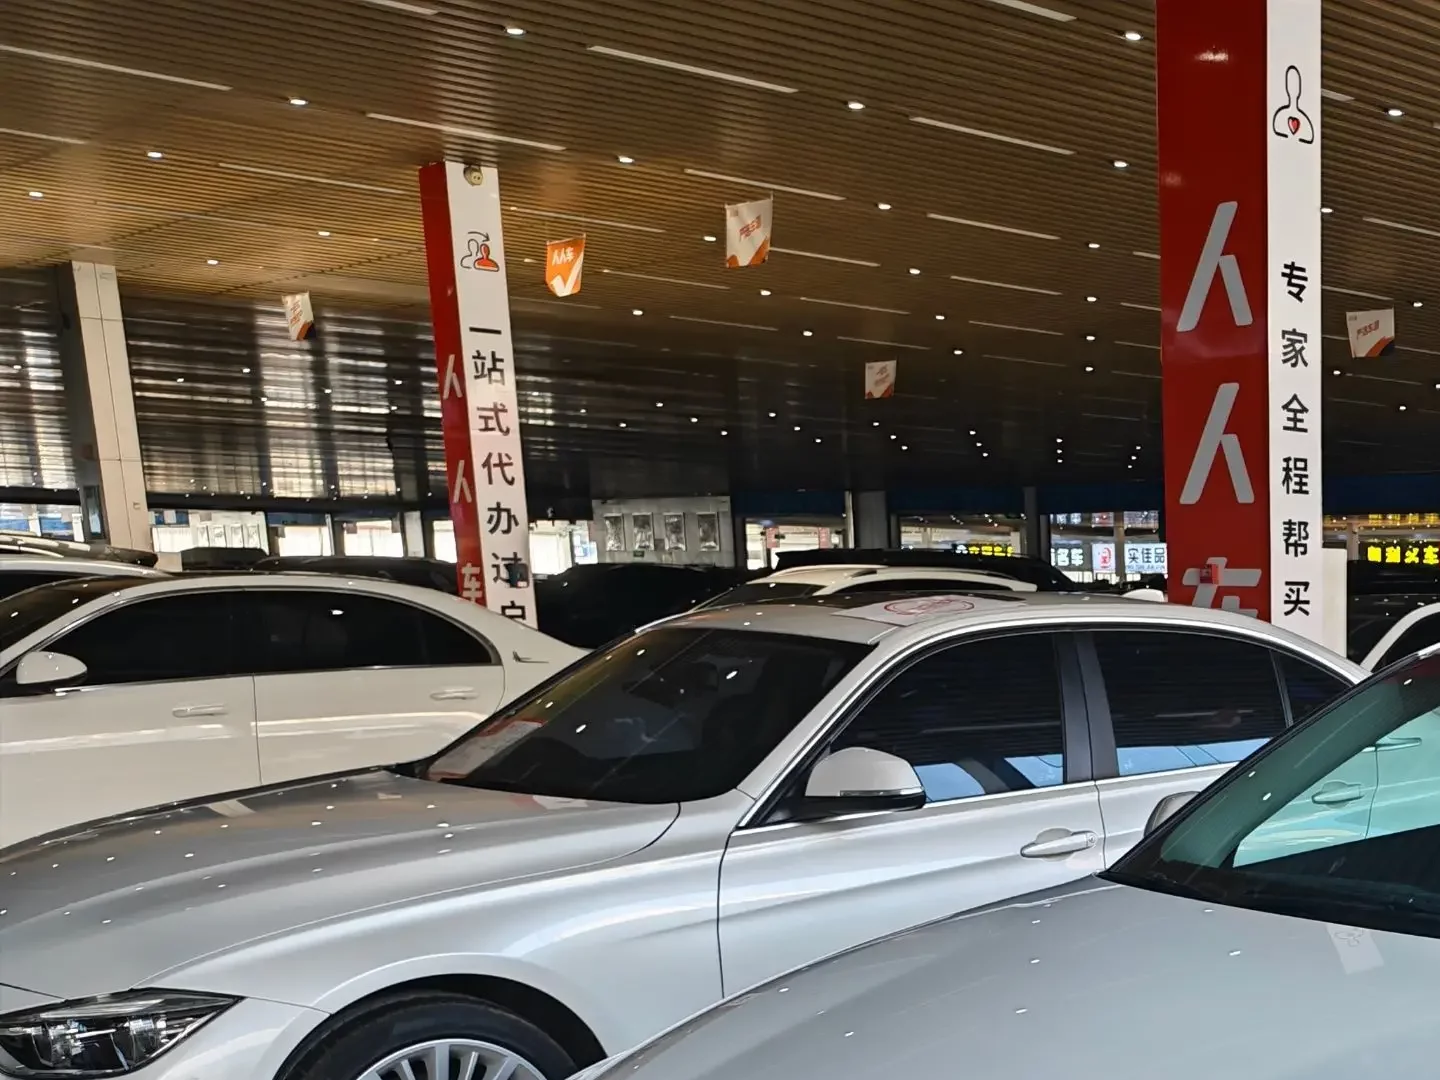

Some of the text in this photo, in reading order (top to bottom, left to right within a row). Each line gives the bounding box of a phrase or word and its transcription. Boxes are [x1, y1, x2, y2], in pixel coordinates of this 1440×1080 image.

[551, 246, 575, 266] 人人车
[442, 354, 483, 603] 人人车
[468, 325, 528, 620] 一站式代办过户
[1280, 261, 1310, 617] 专家全程帮买
